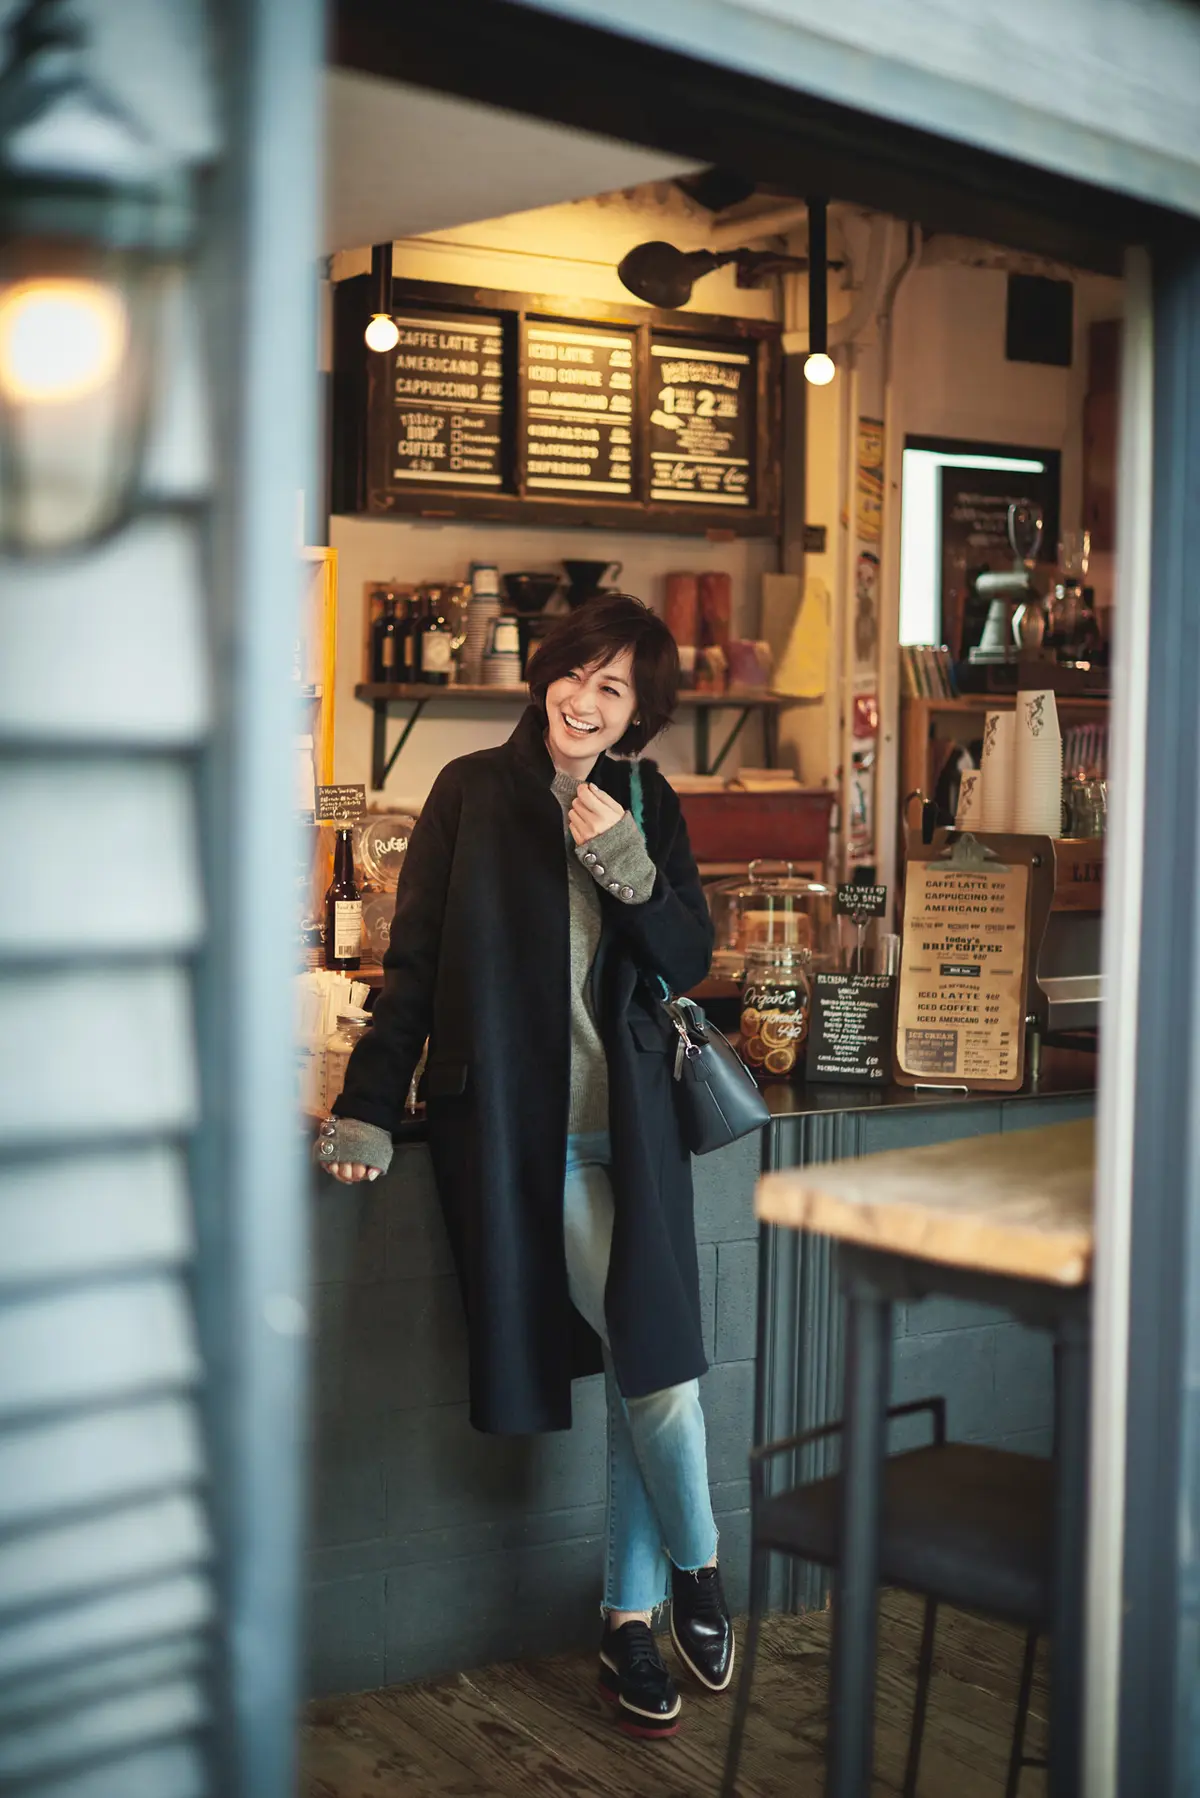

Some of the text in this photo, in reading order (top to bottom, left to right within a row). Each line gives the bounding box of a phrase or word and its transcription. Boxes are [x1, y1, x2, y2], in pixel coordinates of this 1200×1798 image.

[397, 332, 436, 348] CAFFE
[439, 335, 478, 352] LATTE
[396, 355, 478, 376] AMERICANO
[396, 379, 478, 399] CAPPUCCINO
[696, 389, 716, 417] 2
[925, 880, 955, 889] CAFFE
[958, 881, 988, 889] LATTE
[839, 892, 858, 902] COLD
[925, 892, 988, 901] CAPPUCCINO
[924, 904, 988, 913] AMERICANO
[945, 936, 980, 944] today's
[922, 942, 1003, 952] DRIP COFFEE
[744, 986, 796, 1010] Organic
[918, 991, 938, 999] ICED
[940, 992, 980, 1000] LATTE
[917, 1003, 937, 1011] ICED
[939, 1004, 980, 1012] COFFEE
[916, 1015, 936, 1023] ICED
[938, 1016, 979, 1024] AMERICANO
